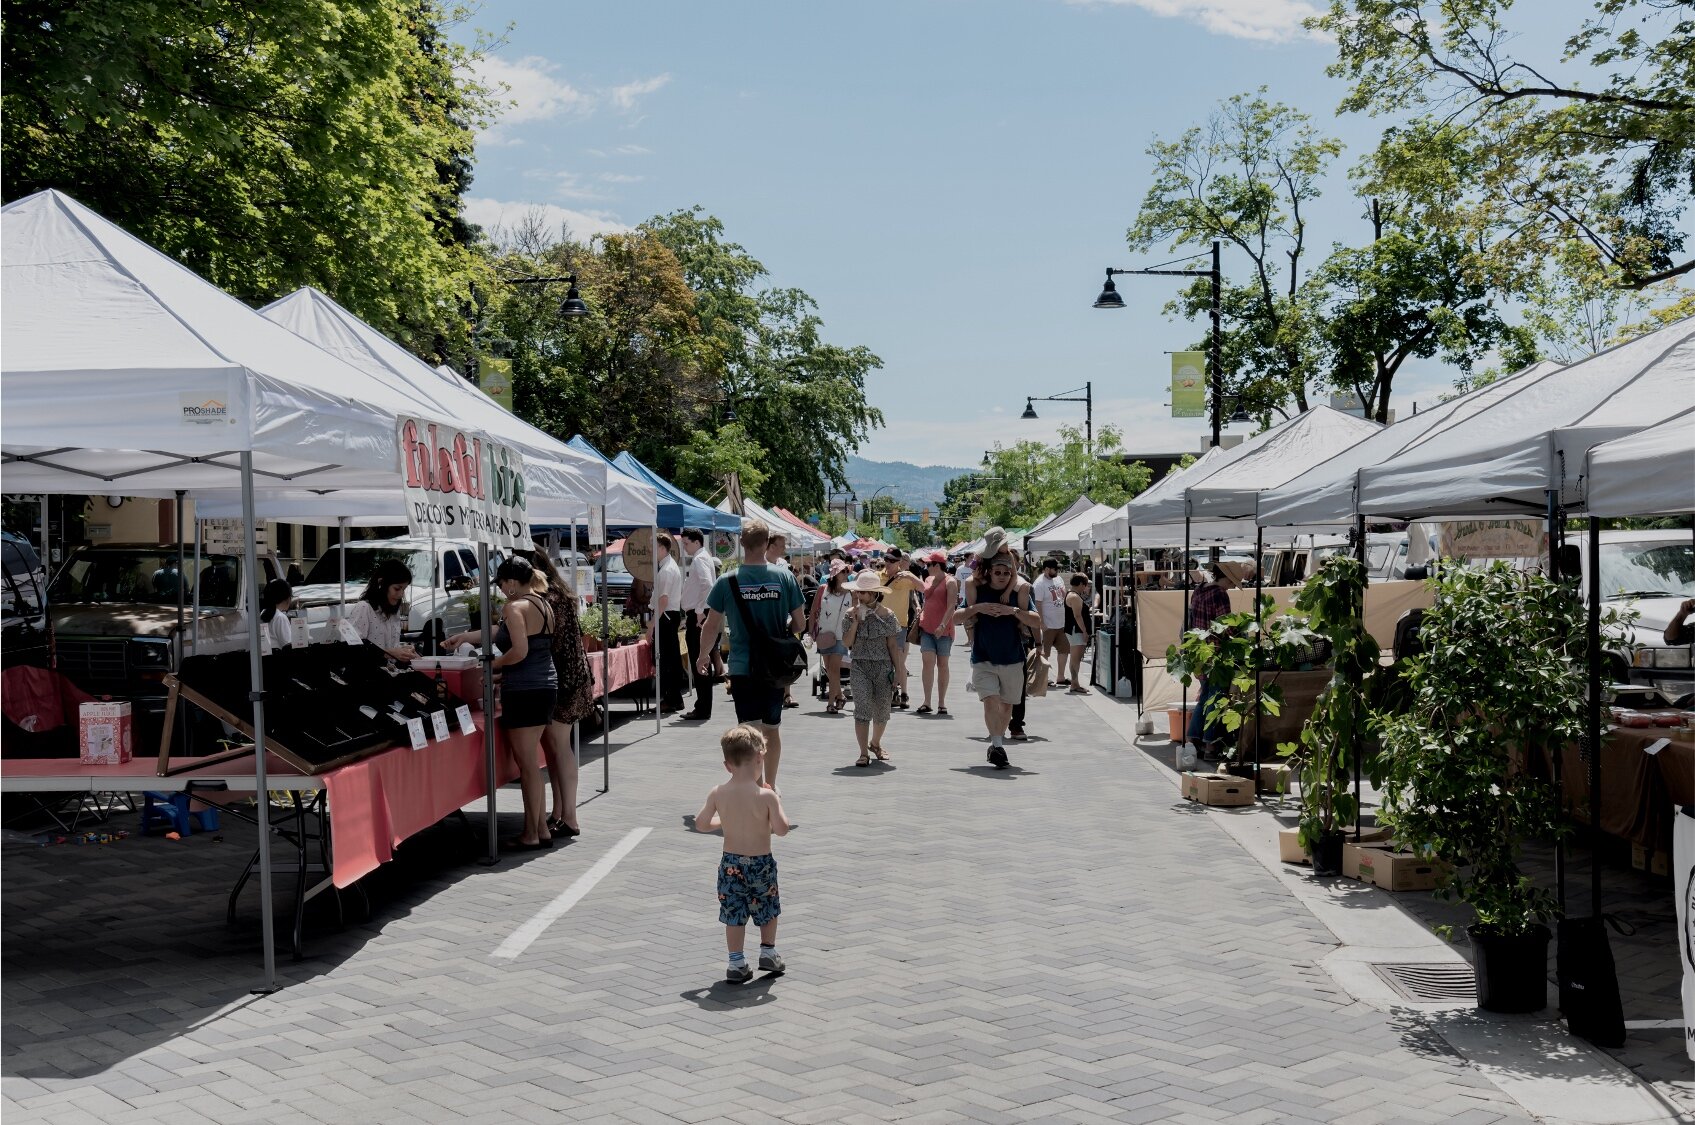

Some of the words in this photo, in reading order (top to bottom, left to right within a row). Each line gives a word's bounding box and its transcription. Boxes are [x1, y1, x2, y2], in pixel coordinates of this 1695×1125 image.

[183, 406, 227, 415] PROSHADE
[487, 443, 526, 512] bie
[627, 542, 646, 556] Food
